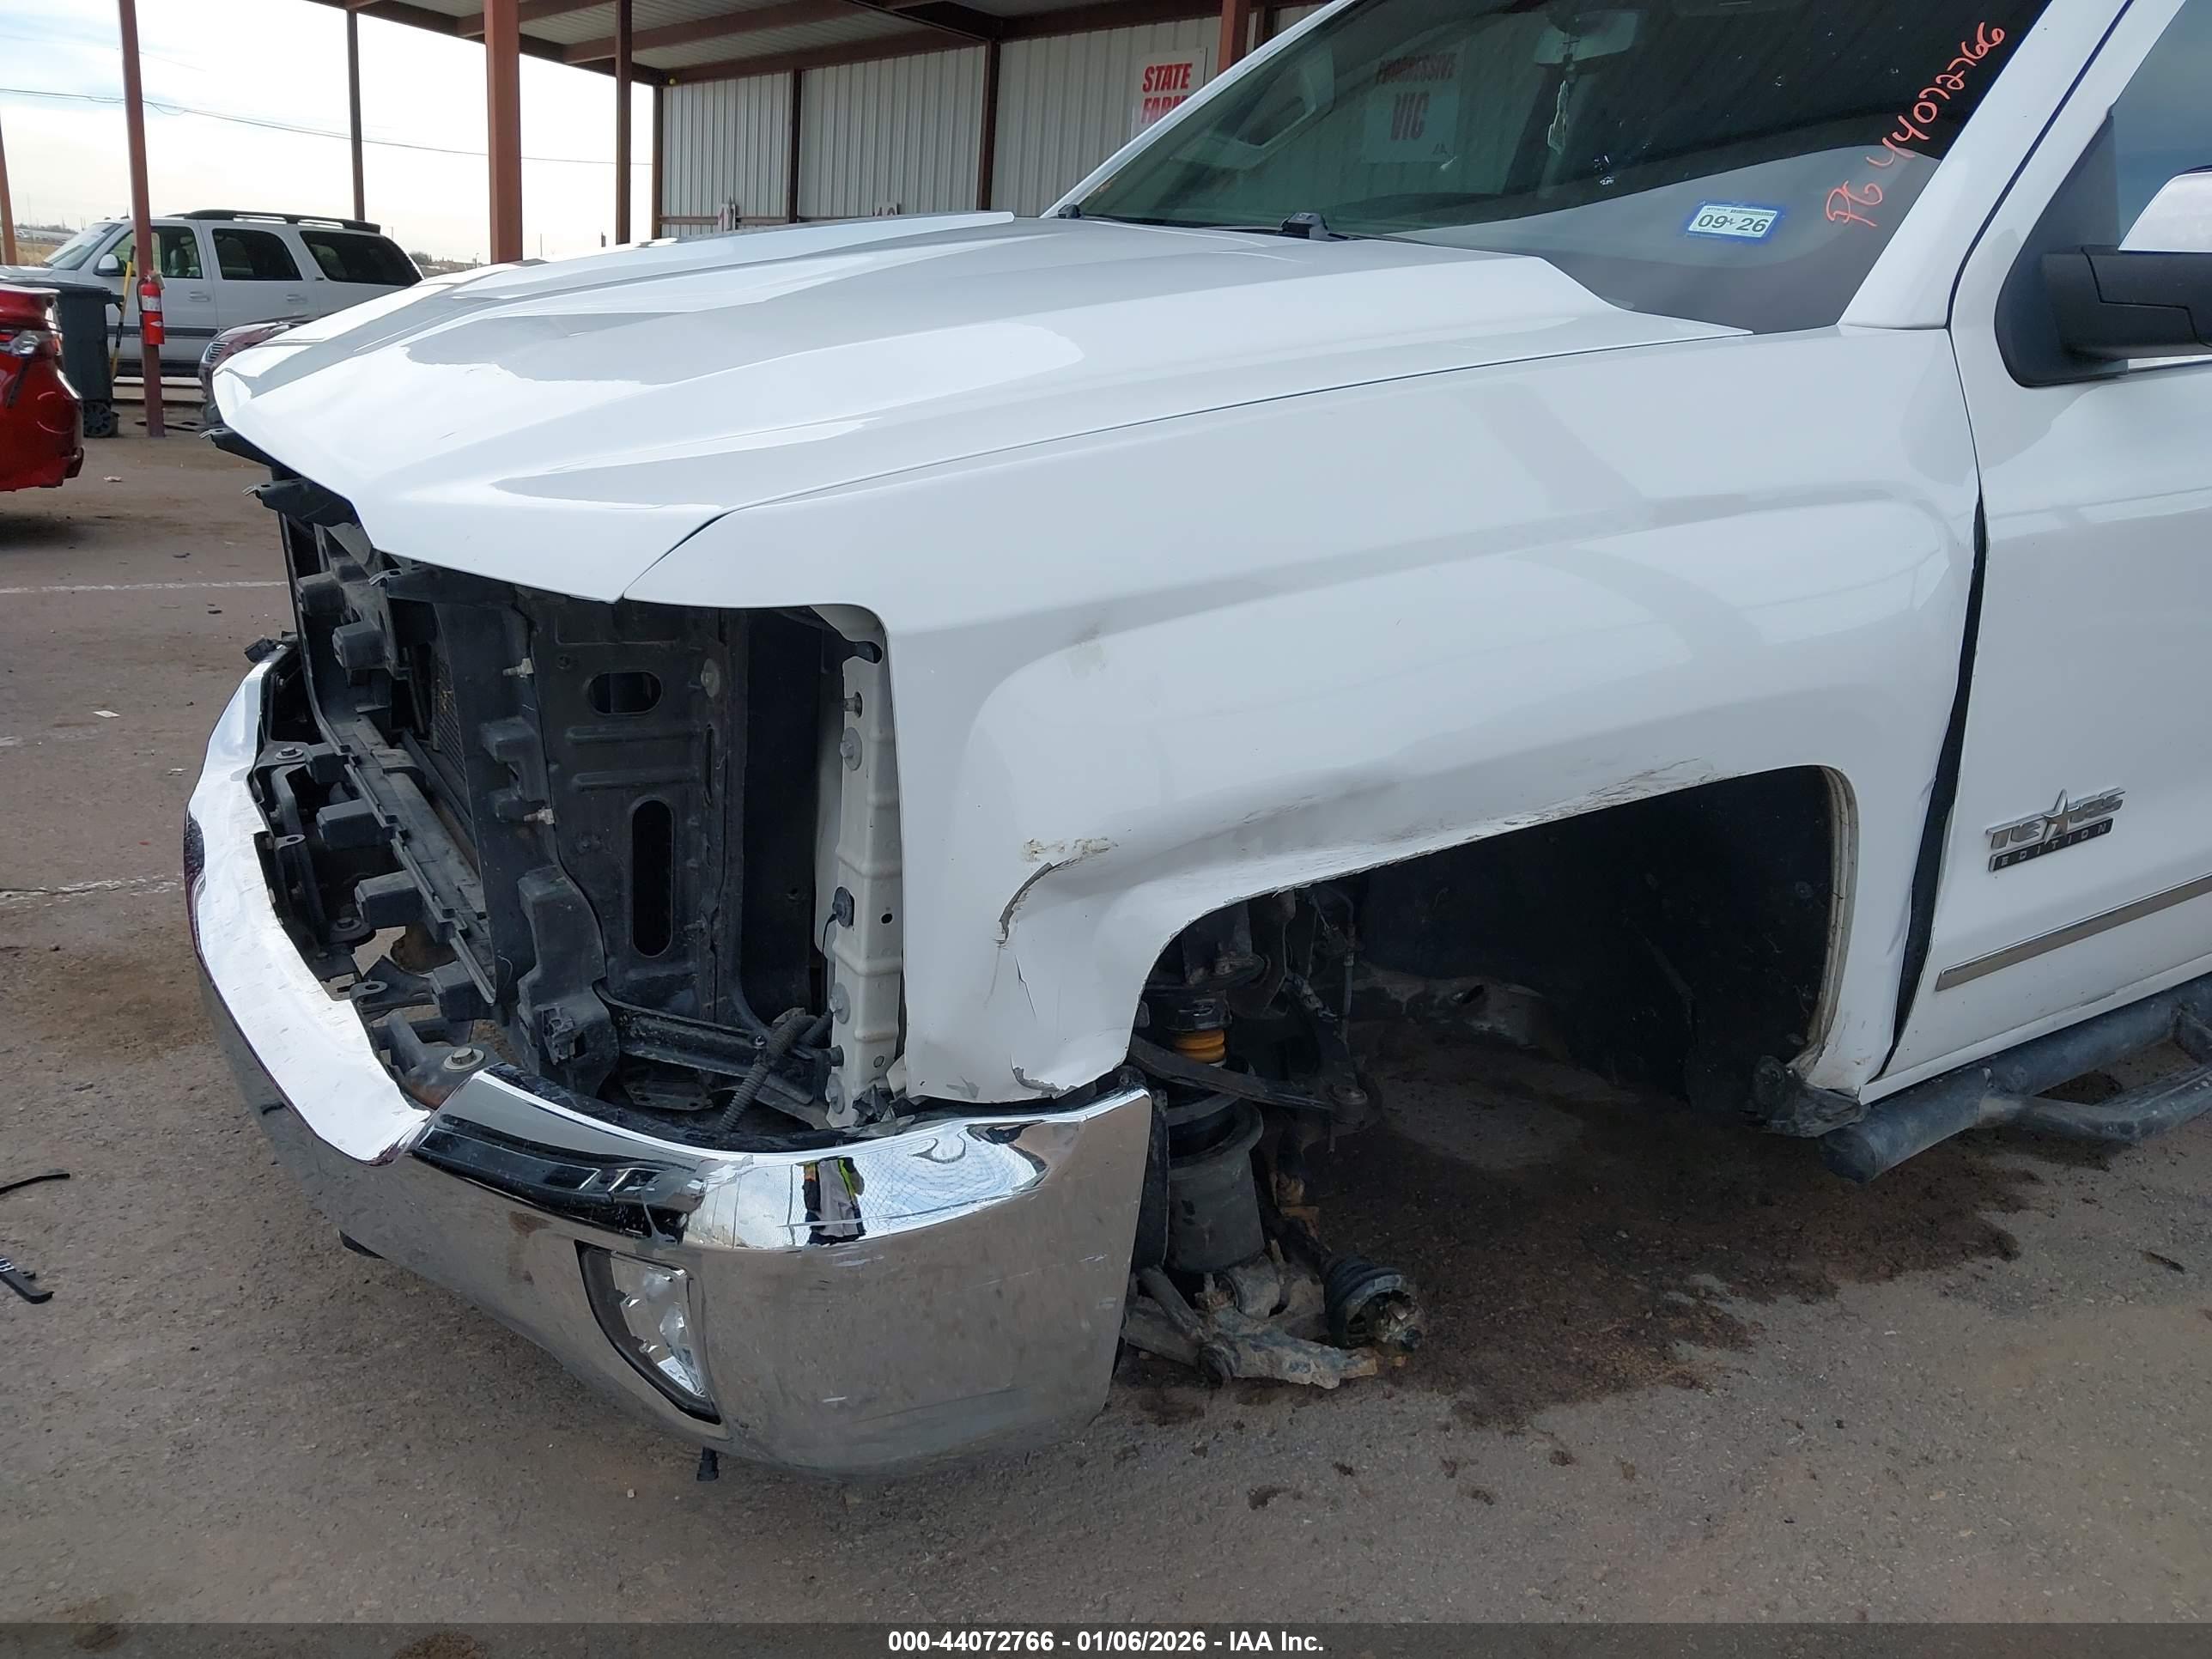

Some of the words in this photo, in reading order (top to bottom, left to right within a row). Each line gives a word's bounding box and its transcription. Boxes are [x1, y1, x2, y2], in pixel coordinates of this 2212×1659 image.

[1142, 63, 1193, 92] STATE
[1866, 21, 2005, 167] 44072766
[1698, 214, 1728, 228] 09
[1736, 217, 1769, 233] 26
[2001, 822, 2108, 866] EDITION
